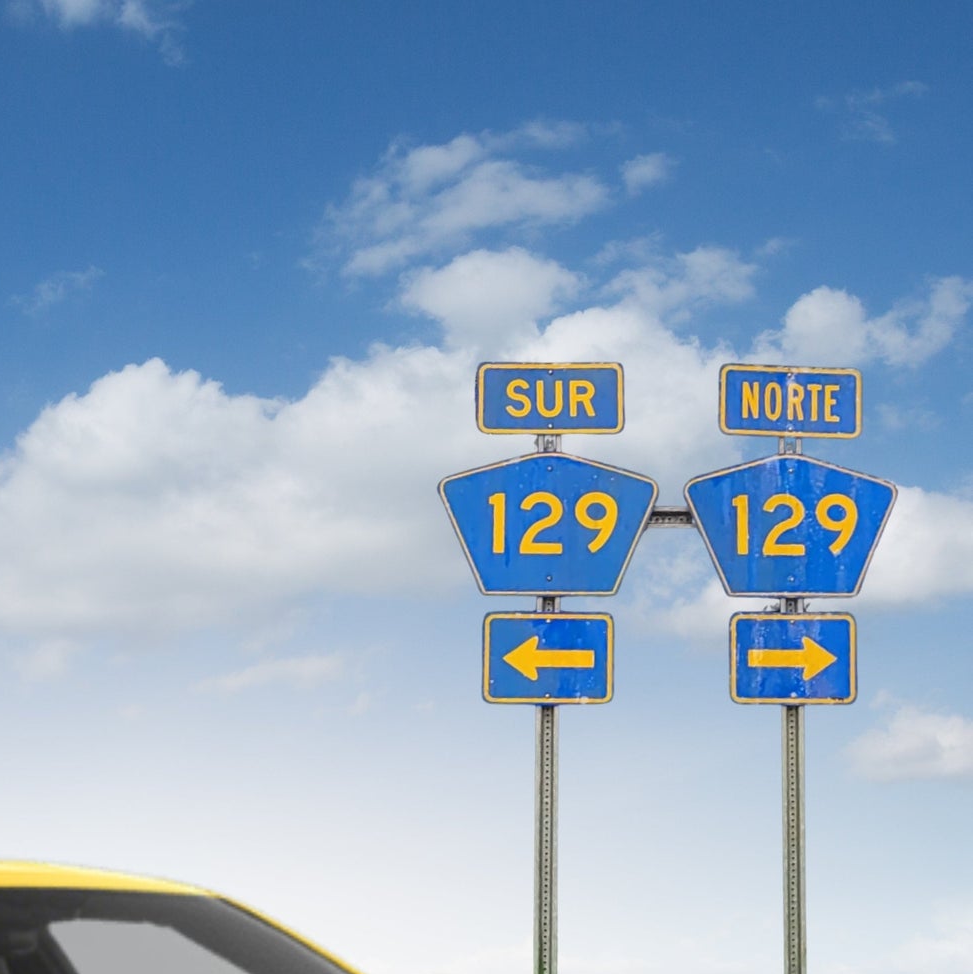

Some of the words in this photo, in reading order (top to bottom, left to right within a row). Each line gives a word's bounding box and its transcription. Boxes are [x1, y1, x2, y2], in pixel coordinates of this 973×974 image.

[506, 378, 596, 418] SUR
[741, 382, 840, 422] NORTE
[488, 491, 619, 555] 129
[732, 493, 859, 556] 129
